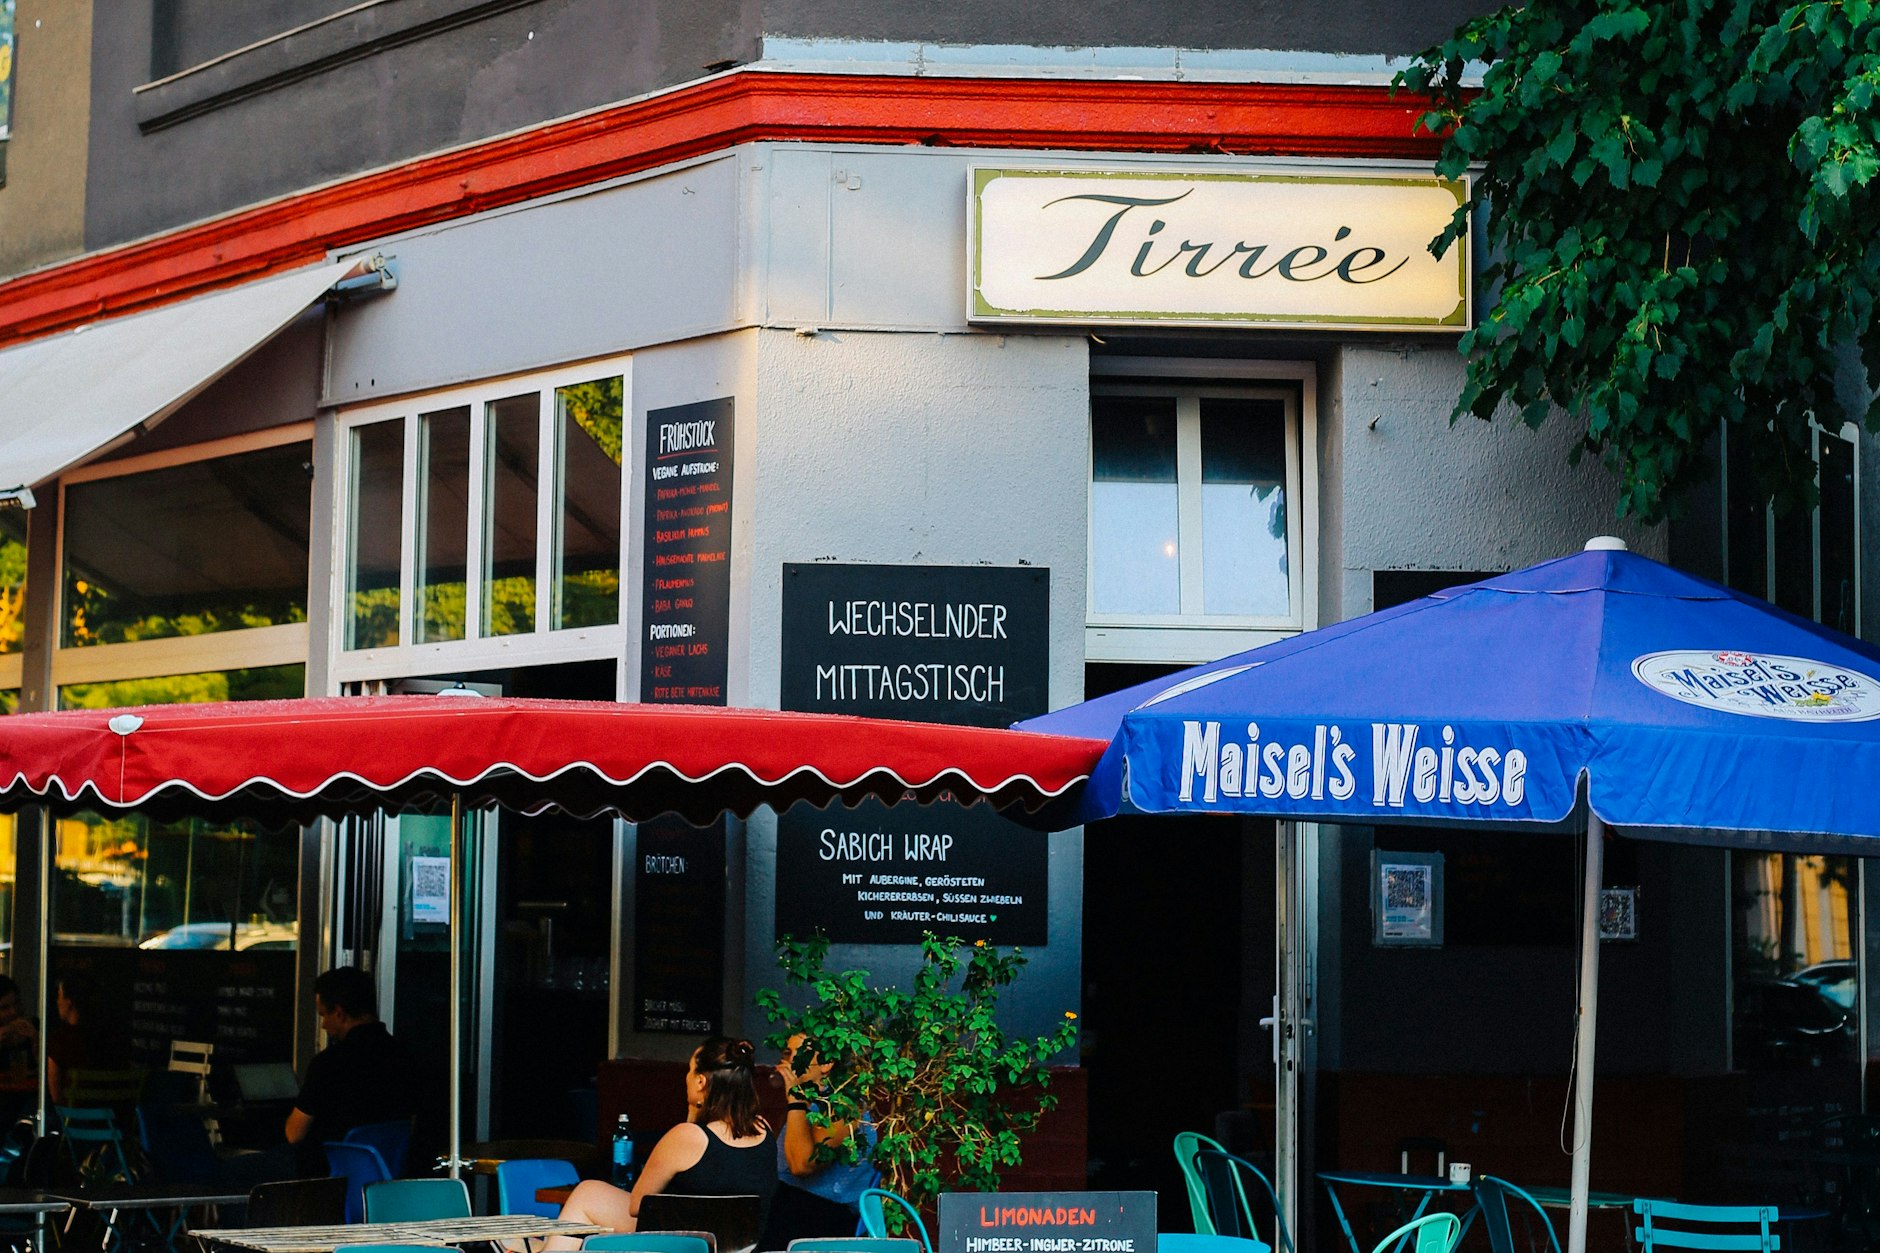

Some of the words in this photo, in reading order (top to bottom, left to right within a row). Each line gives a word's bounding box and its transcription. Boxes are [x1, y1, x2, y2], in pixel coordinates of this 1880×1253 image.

[660, 420, 716, 454] FRÜHSTÜCK
[652, 465, 679, 480] VEGANE
[650, 624, 696, 641] PORTIONEN:
[828, 600, 1008, 640] WECHSELNDER
[816, 664, 1004, 702] MITTAGSTISCH
[1661, 659, 1801, 698] Maisel's
[1737, 673, 1860, 706] Weisse
[1178, 720, 1357, 803] Maisel's
[1371, 723, 1527, 808] Weisse
[819, 829, 893, 862] SABICH
[904, 833, 953, 862] WRAP
[842, 873, 863, 885] MIT
[869, 874, 922, 888] AUBERGINE,
[924, 874, 985, 887] GERÖSTETEN
[942, 892, 978, 904] SÜSSEN
[864, 910, 884, 920] UND
[980, 1206, 1096, 1228] LIMONADEN
[966, 1236, 1134, 1253] HIMBEER-INGWER-ZITRONE
